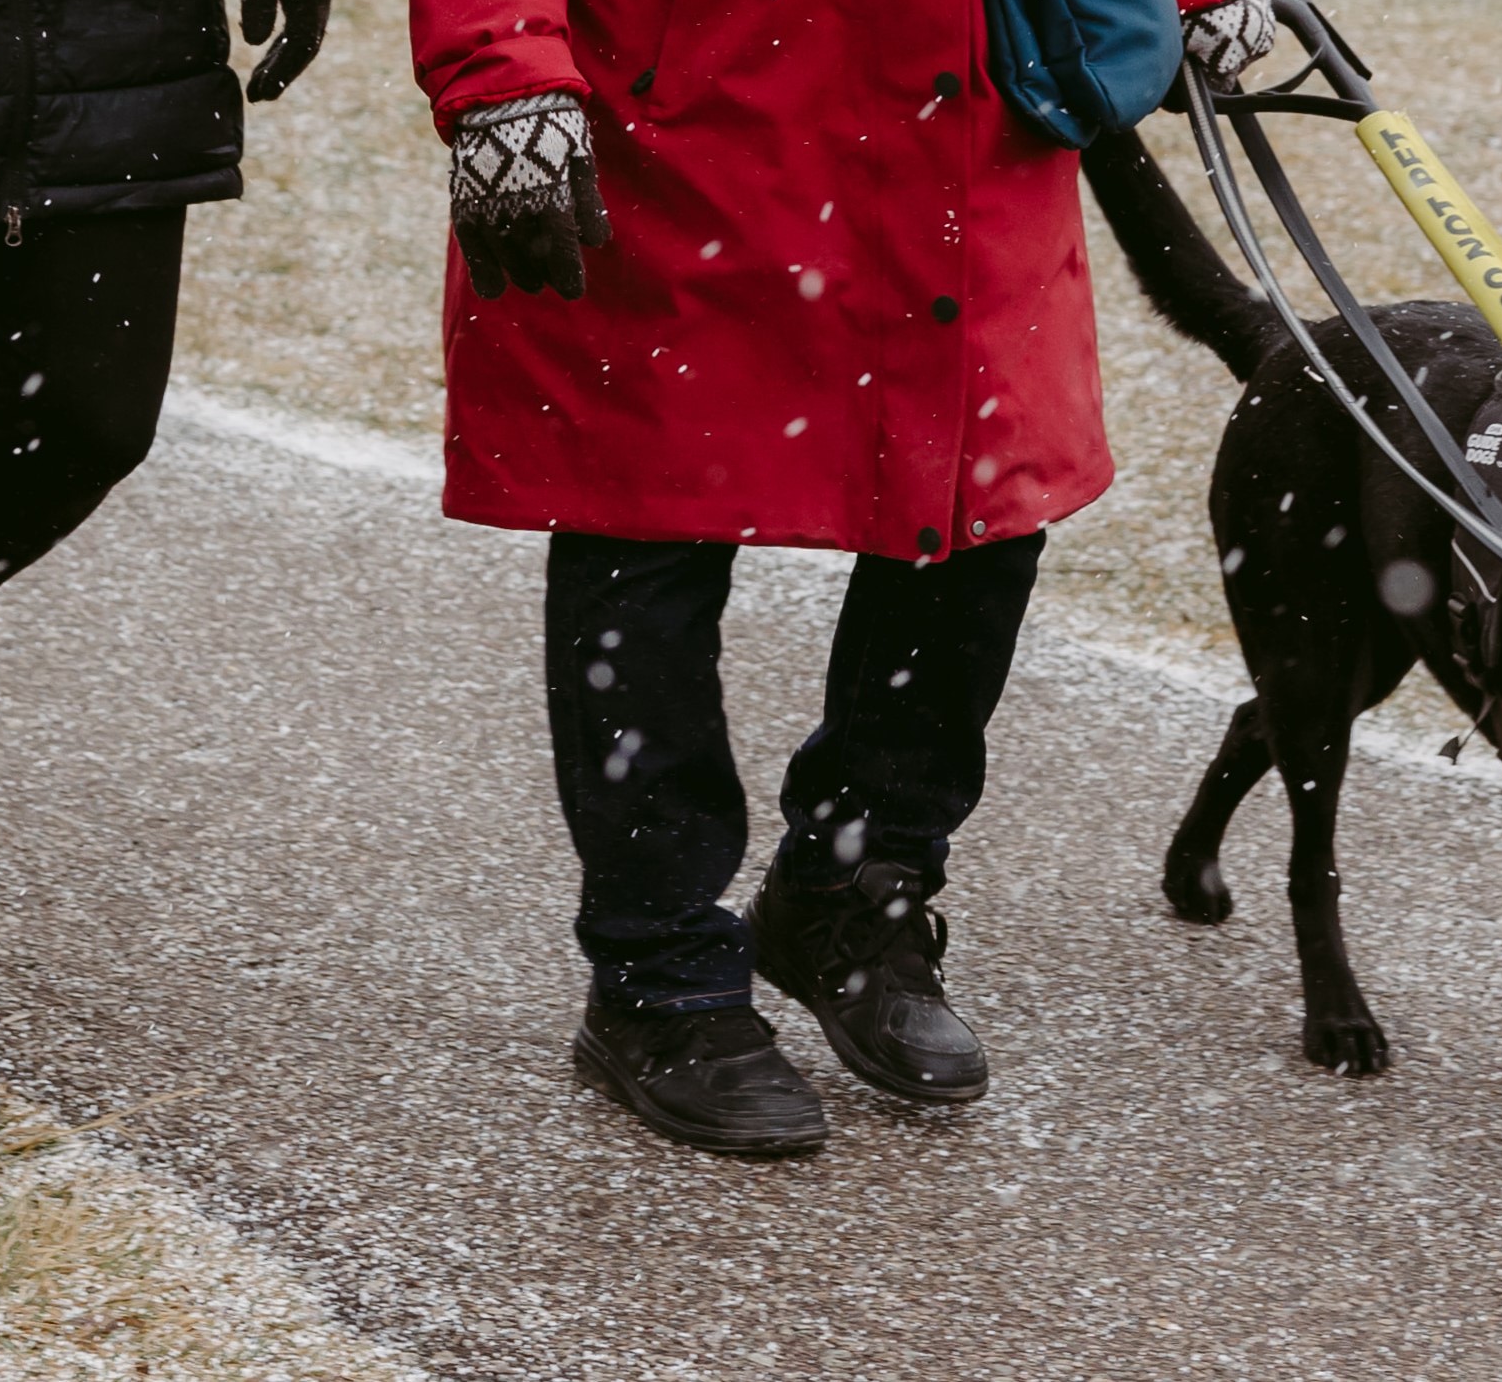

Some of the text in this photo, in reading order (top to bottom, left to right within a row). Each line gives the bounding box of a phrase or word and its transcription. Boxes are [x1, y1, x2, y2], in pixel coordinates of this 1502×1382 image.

[1380, 129, 1438, 189] PET
[1426, 196, 1495, 261] NOT
[1465, 448, 1497, 465] DOGS
[1466, 433, 1502, 451] GUIDE
